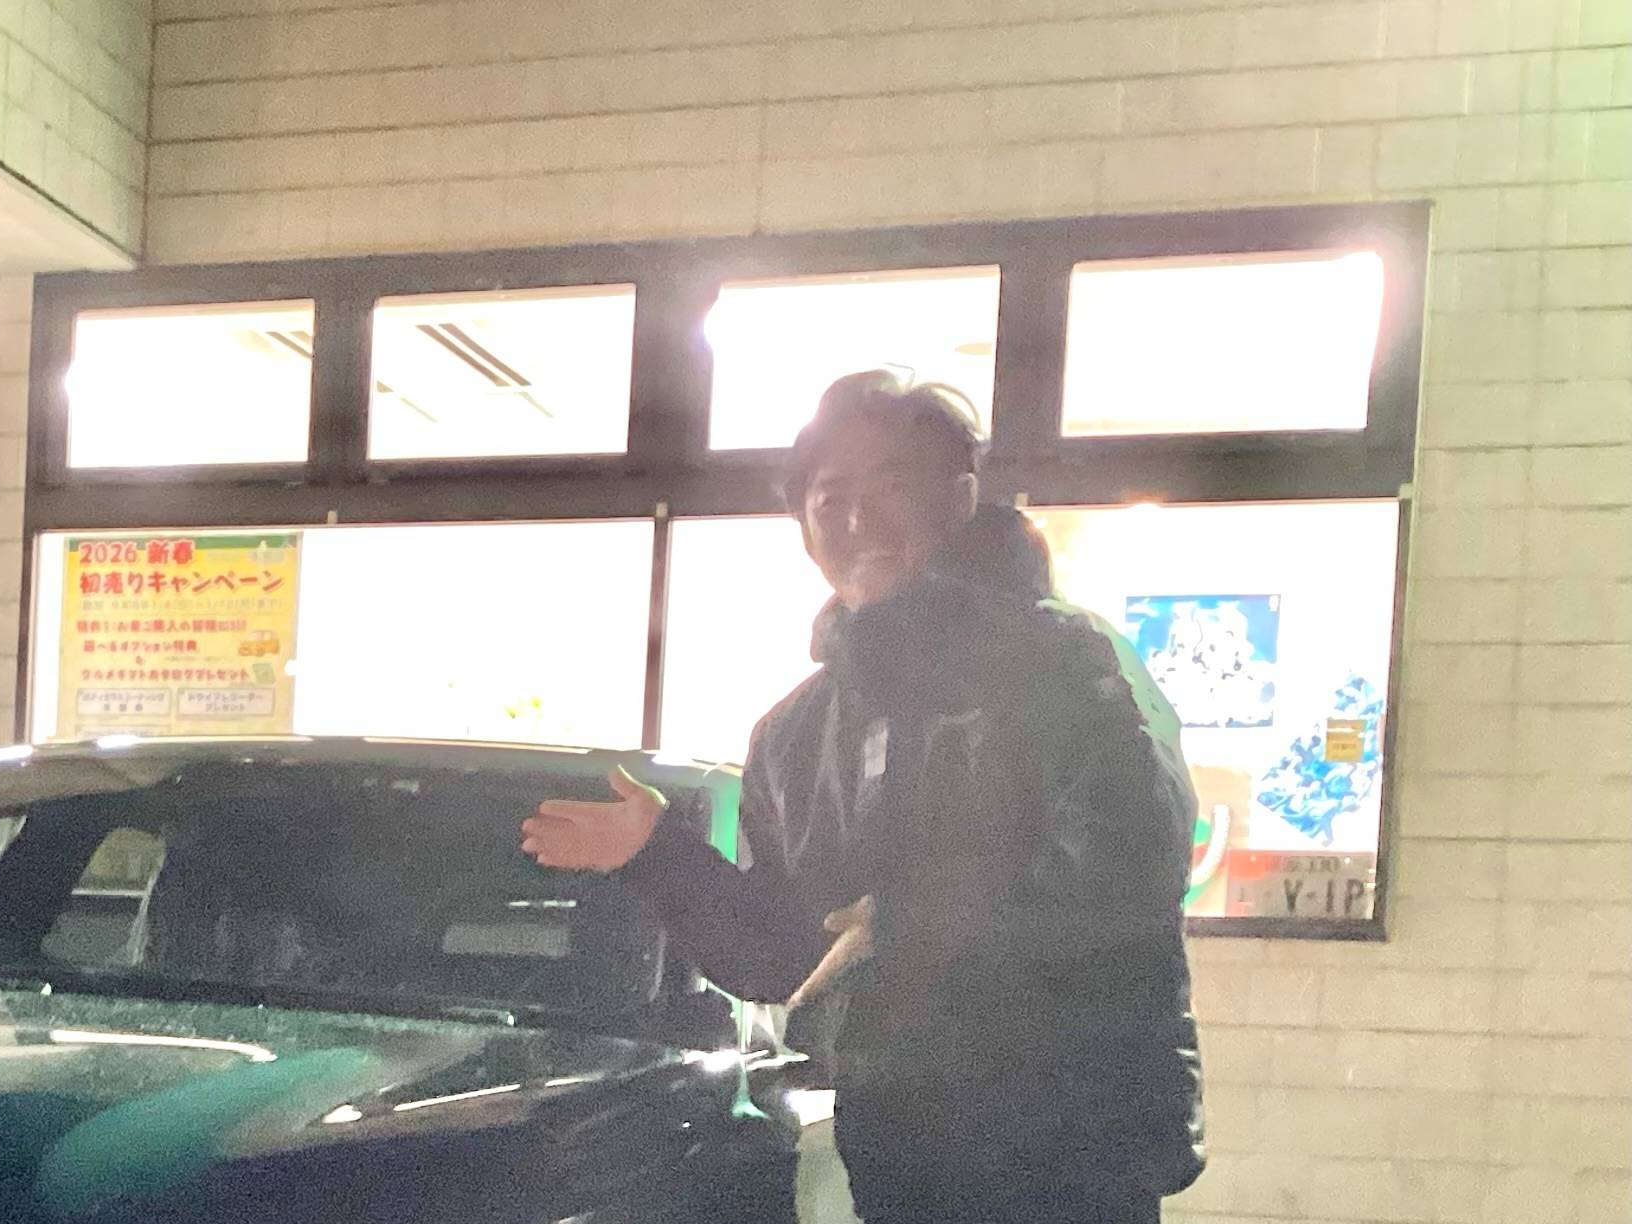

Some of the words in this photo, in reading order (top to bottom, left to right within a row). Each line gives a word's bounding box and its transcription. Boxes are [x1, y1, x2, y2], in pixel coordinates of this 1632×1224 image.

[79, 543, 137, 564] 2026
[147, 541, 193, 564] 新春
[79, 570, 282, 594] 初売りキャンペーン
